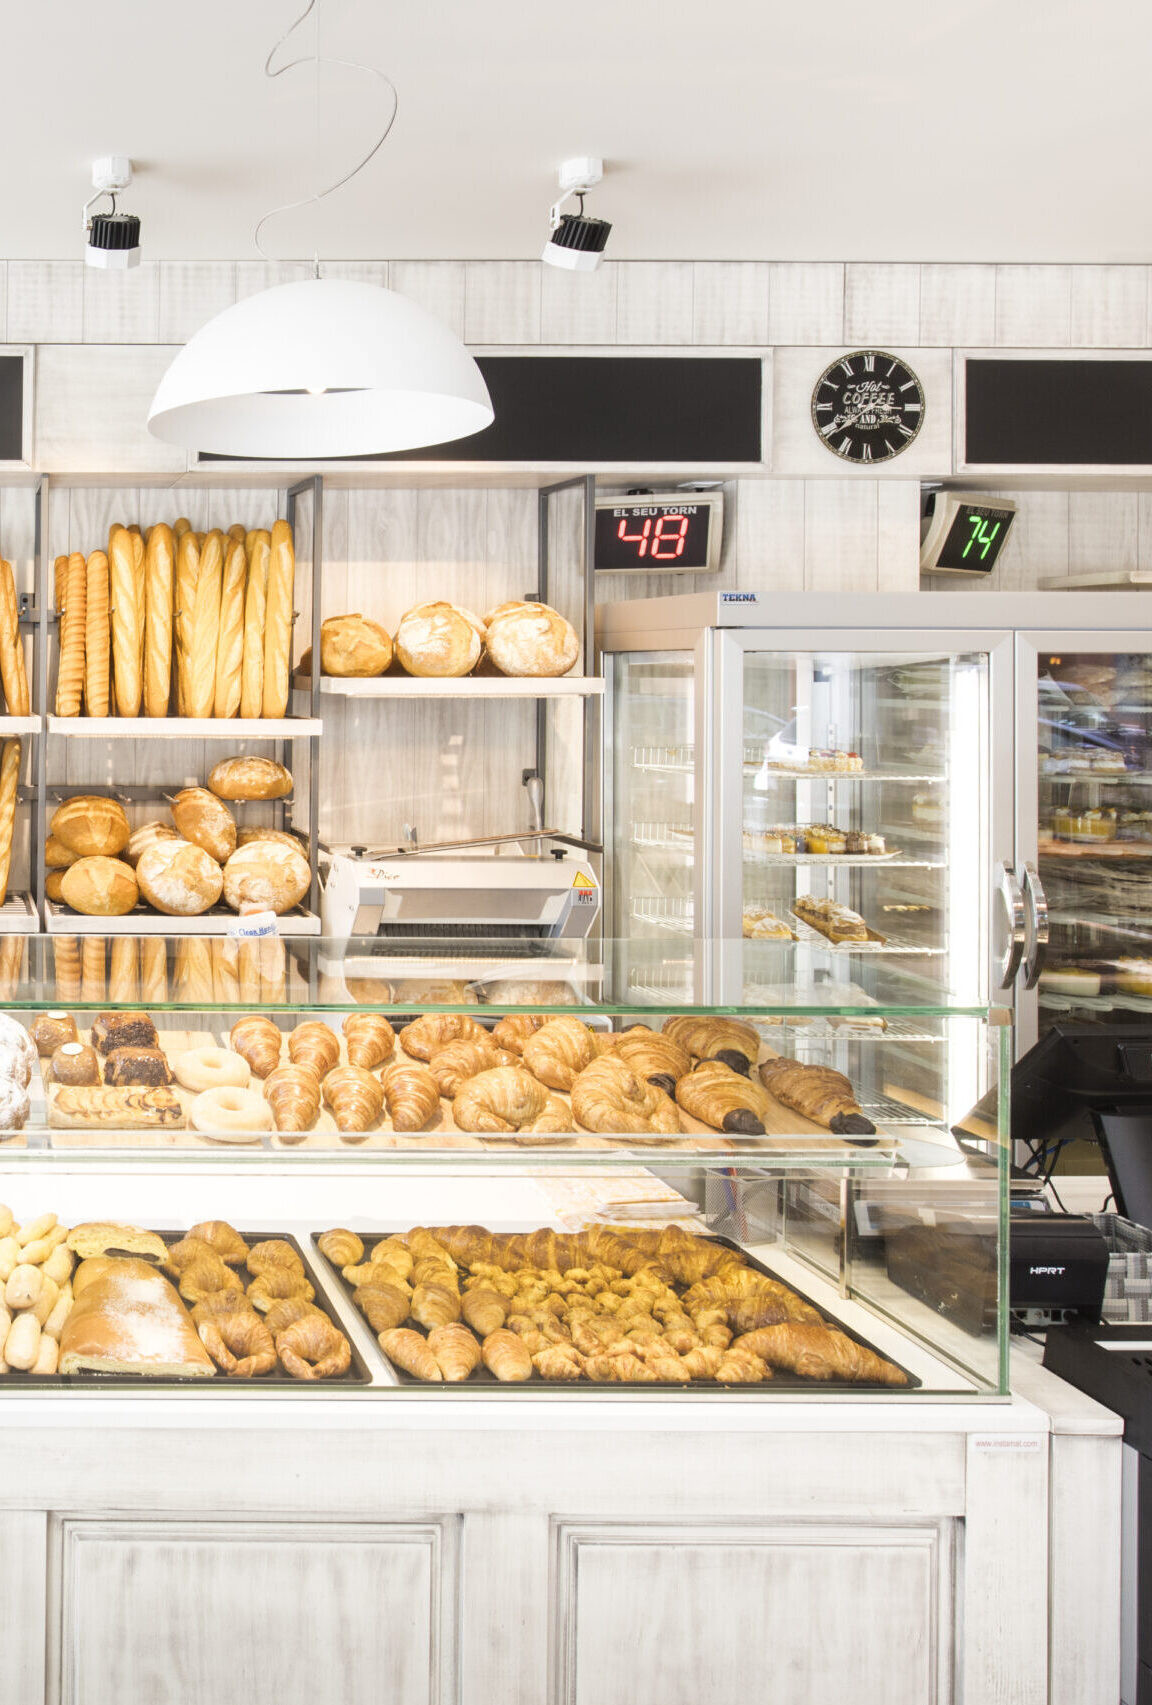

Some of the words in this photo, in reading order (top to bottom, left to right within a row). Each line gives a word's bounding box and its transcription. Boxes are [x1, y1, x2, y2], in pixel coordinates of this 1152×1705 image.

[856, 380, 882, 393] Hot
[843, 391, 895, 405] COFFEE
[860, 414, 877, 423] AND
[613, 509, 629, 517] EL
[632, 507, 658, 516] SEU
[661, 505, 697, 515] TORN
[617, 514, 689, 559] 48
[962, 515, 1001, 560] 74
[722, 593, 757, 602] TEKNA
[1029, 1266, 1066, 1275] HPRT
